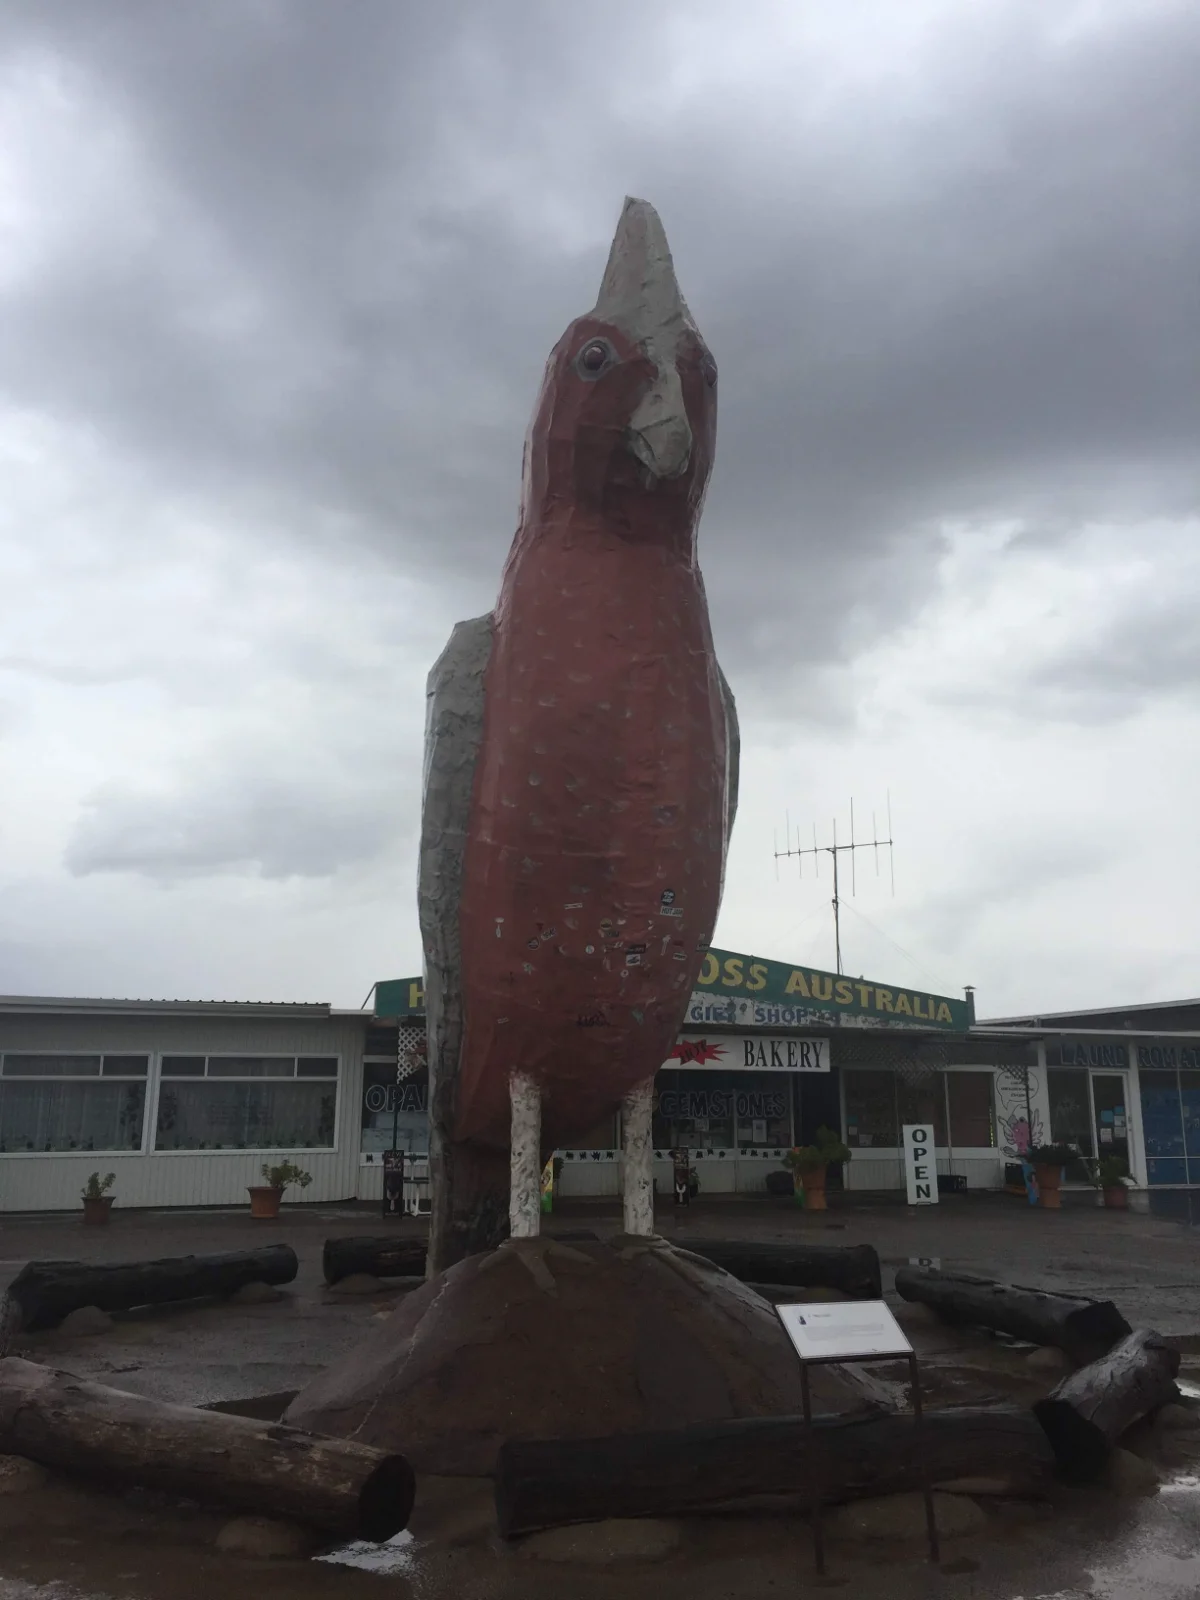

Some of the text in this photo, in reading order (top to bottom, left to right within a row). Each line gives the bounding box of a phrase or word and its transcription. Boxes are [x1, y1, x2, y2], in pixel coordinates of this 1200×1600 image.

[784, 970, 952, 1023] AUSTRALIA
[755, 1006, 808, 1024] SHOP
[744, 1039, 823, 1068] BAKERY
[660, 1089, 786, 1118] GEMSTONES
[912, 1129, 931, 1198] OPEN
